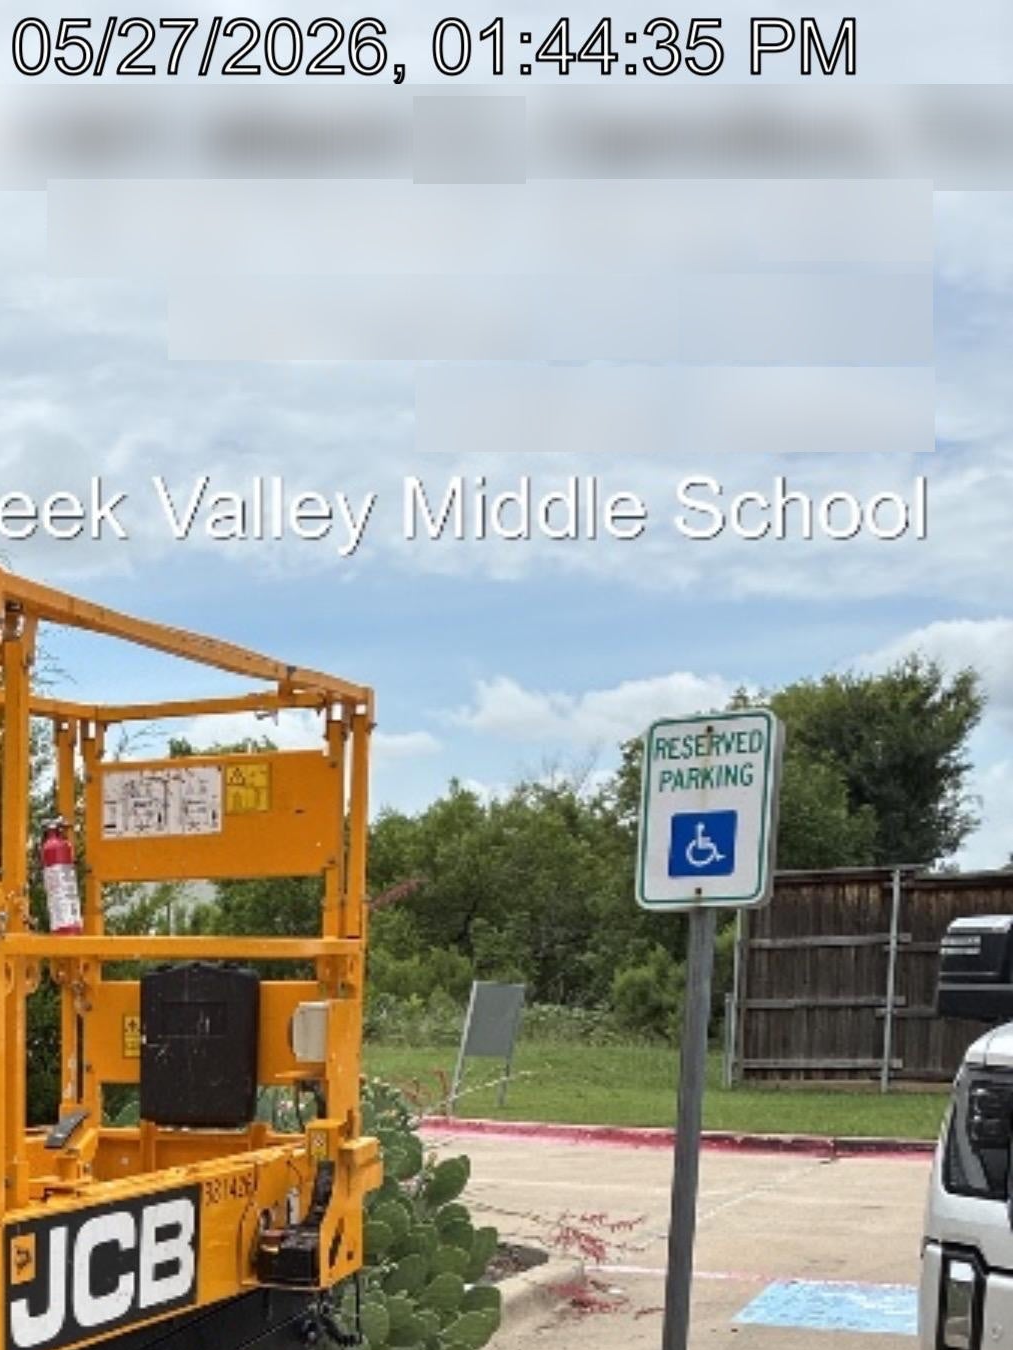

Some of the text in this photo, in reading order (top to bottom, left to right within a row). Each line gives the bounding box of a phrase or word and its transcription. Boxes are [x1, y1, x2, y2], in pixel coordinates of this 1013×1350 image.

[652, 729, 764, 761] RESERVED
[658, 761, 755, 793] PARKING
[9, 1198, 196, 1348] JCB
